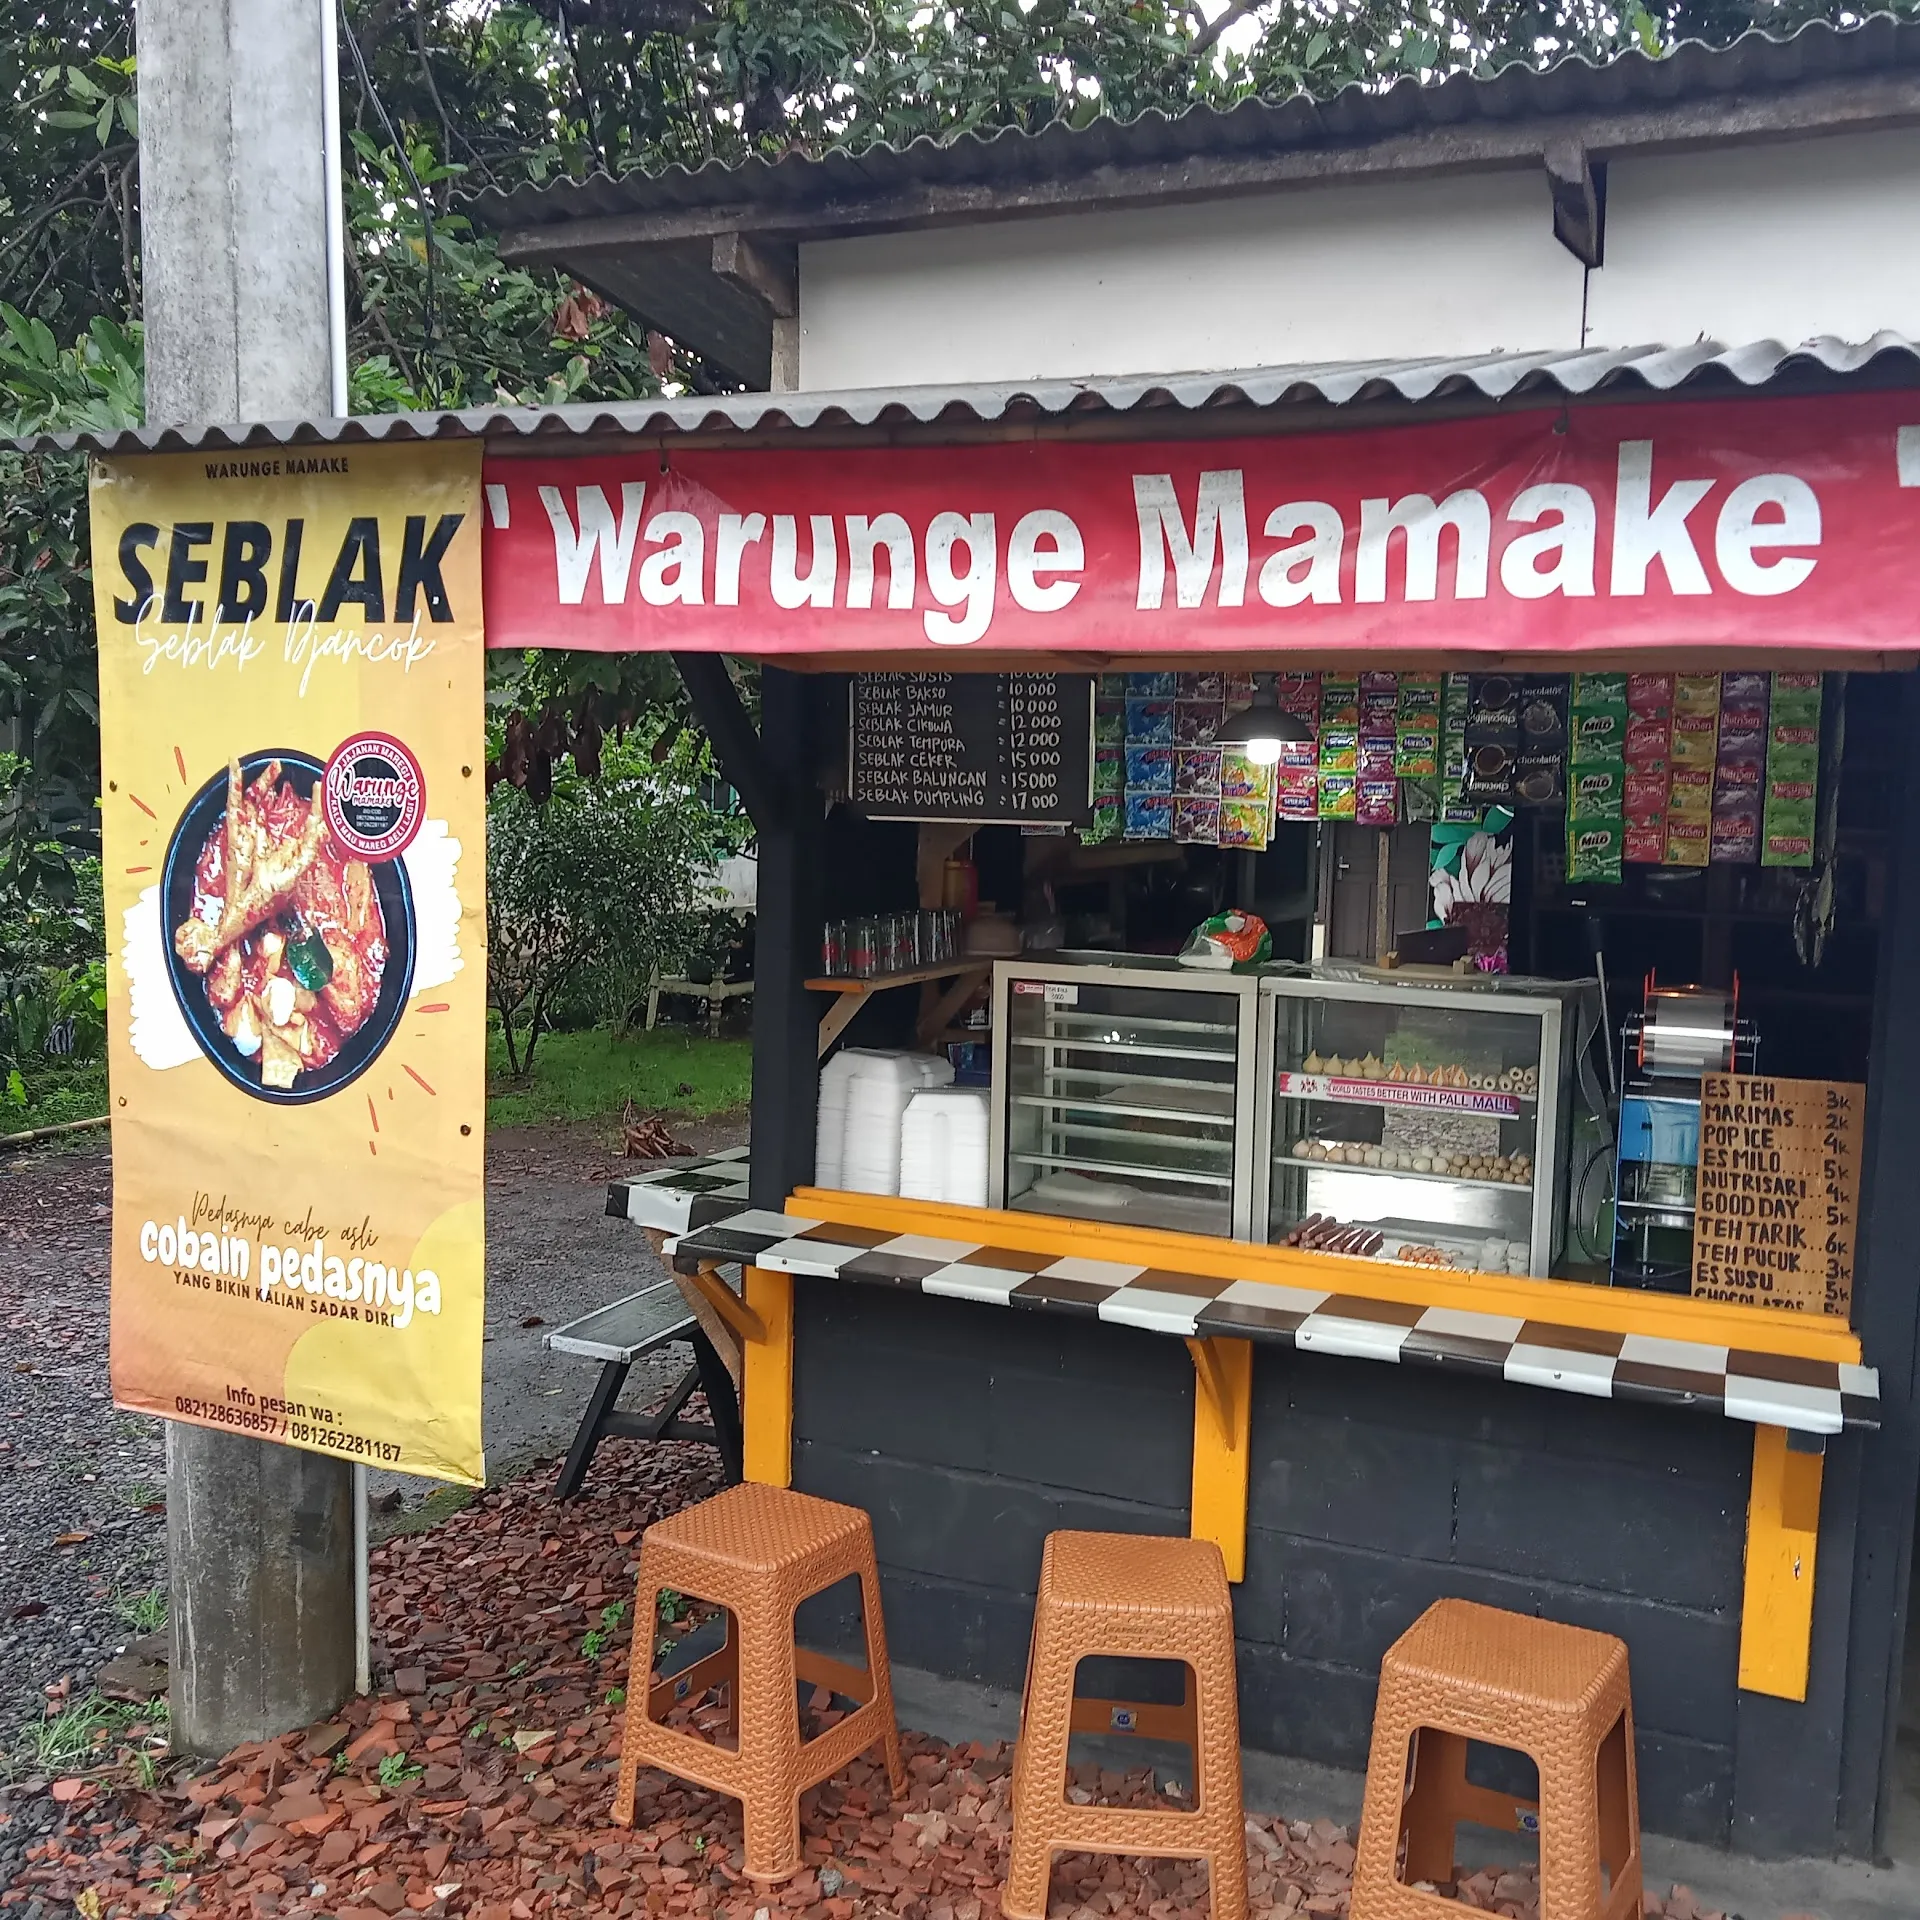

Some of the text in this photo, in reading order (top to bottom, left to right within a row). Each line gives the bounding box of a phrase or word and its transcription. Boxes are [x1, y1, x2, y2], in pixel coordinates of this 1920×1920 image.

[205, 457, 350, 479] WARUNGE MAMAKE
[538, 439, 1822, 645] Warunge Mamake
[114, 514, 466, 624] SEBLAK
[858, 685, 901, 700] SEBLAK
[906, 685, 946, 701] BAKSO
[858, 700, 902, 716] SEBLAK
[908, 702, 953, 718] JAMUR
[858, 717, 903, 732] SEBLAK
[907, 717, 953, 734] CIKUWA
[858, 734, 905, 749] SEBLAK
[909, 735, 966, 753] TEMPURA
[341, 744, 412, 779] JAJANAN MAREGI
[859, 752, 905, 768] SEBLAK
[910, 752, 958, 769] CEKER
[328, 766, 418, 806] Warunge
[858, 770, 909, 786] SEBLAK
[912, 770, 987, 788] BALUNGAN
[857, 788, 909, 804] SEBLAK
[914, 787, 985, 808] DUMPLING
[331, 799, 415, 850] KALO MAU WAREG BELI LAGI
[1332, 1085, 1351, 1094] WORLD
[1352, 1086, 1377, 1097] TASTES
[1377, 1088, 1409, 1100] BETTER
[1410, 1089, 1438, 1104] WITH
[1440, 1092, 1470, 1108] PALL
[1472, 1096, 1515, 1113] MALL
[1704, 1079, 1730, 1099] ES
[1736, 1080, 1775, 1102] TEH
[1704, 1103, 1794, 1127] MARIMAS
[1703, 1124, 1739, 1148] POP
[1743, 1127, 1775, 1149] ICE
[1703, 1147, 1729, 1168] ES
[1732, 1149, 1781, 1174] MILO
[1702, 1169, 1806, 1199] NUTRISARI
[1701, 1191, 1755, 1217] GOOD
[1758, 1197, 1800, 1220] DAY
[192, 1191, 379, 1250] Pedasnya cabe asli
[1698, 1216, 1742, 1241] TEH
[1747, 1222, 1807, 1249] TARIK
[140, 1215, 443, 1329] cobain pedasnya
[1697, 1242, 1738, 1265] TEH
[1744, 1246, 1801, 1273] PUCUK
[1696, 1261, 1719, 1285] ES
[1724, 1267, 1774, 1292] SUSU
[173, 1270, 395, 1328] YANG BIKIN KALIAN SADAR DIRI
[226, 1384, 256, 1408] Info
[259, 1394, 307, 1419] pesan
[309, 1404, 334, 1424] wa
[175, 1395, 278, 1434] 082128636857
[291, 1422, 401, 1462] 081262281187
